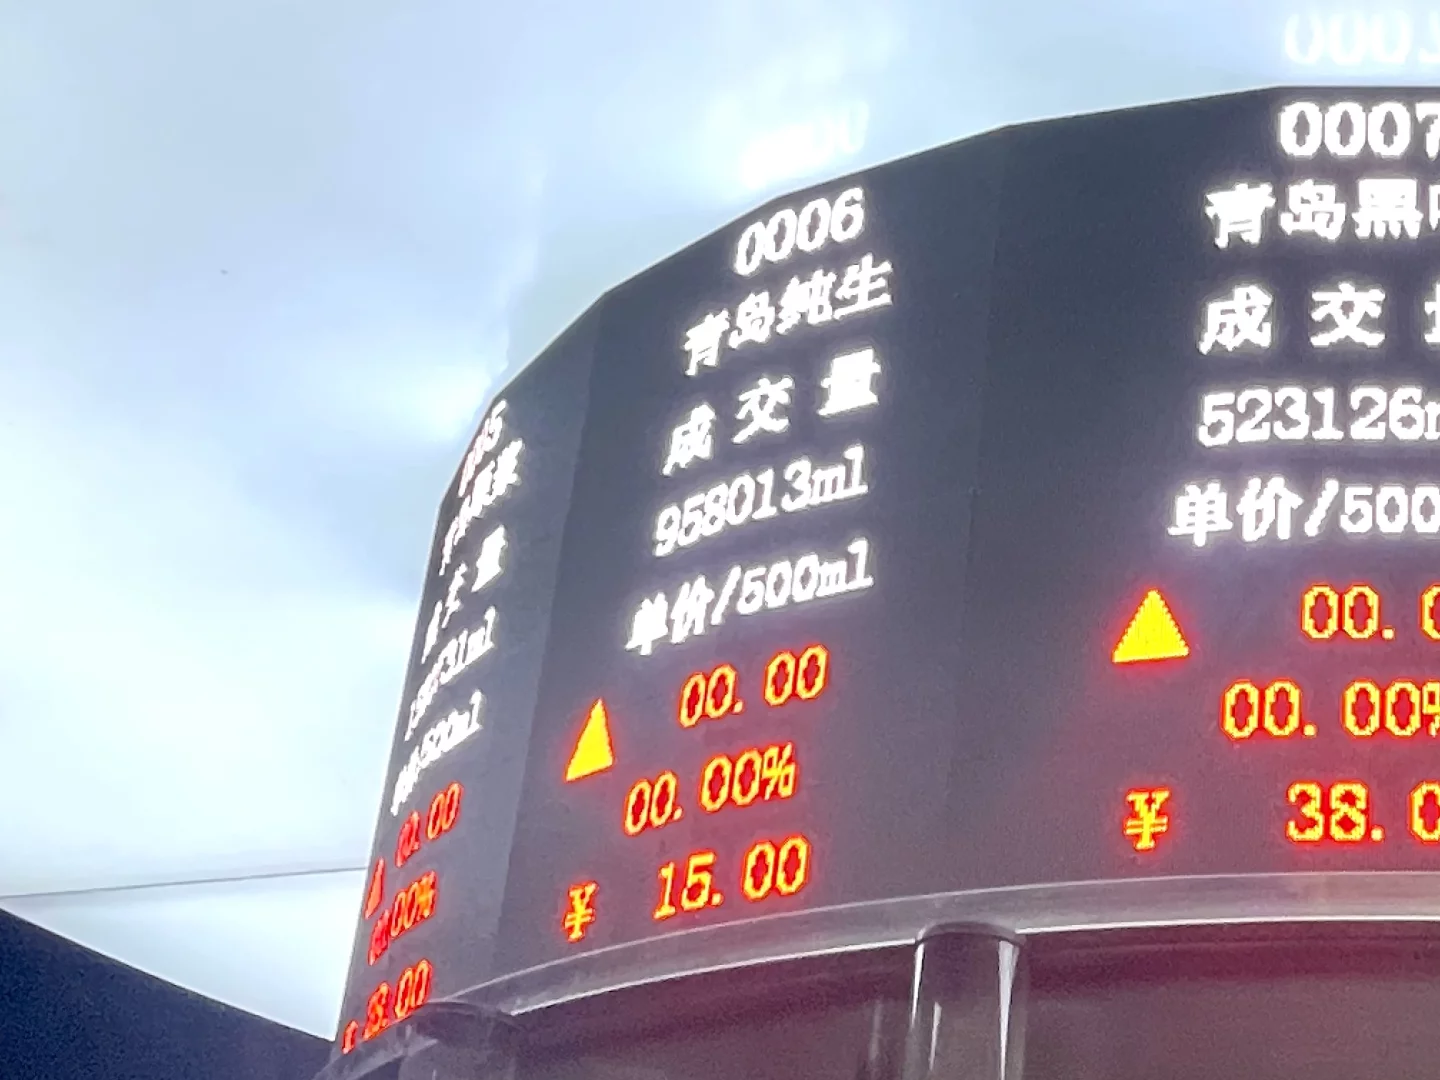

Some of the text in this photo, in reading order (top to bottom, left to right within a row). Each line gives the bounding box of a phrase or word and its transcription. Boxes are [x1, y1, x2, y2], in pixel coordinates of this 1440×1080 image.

[734, 186, 865, 275] 0006
[683, 256, 894, 376] 青岛纯生
[662, 347, 882, 474] 成交量
[654, 445, 868, 557] 958013ml
[626, 537, 874, 656] 单价/500ml
[678, 644, 828, 726] 00.00
[624, 742, 798, 838] 00.00%
[653, 833, 811, 920] 15.00
